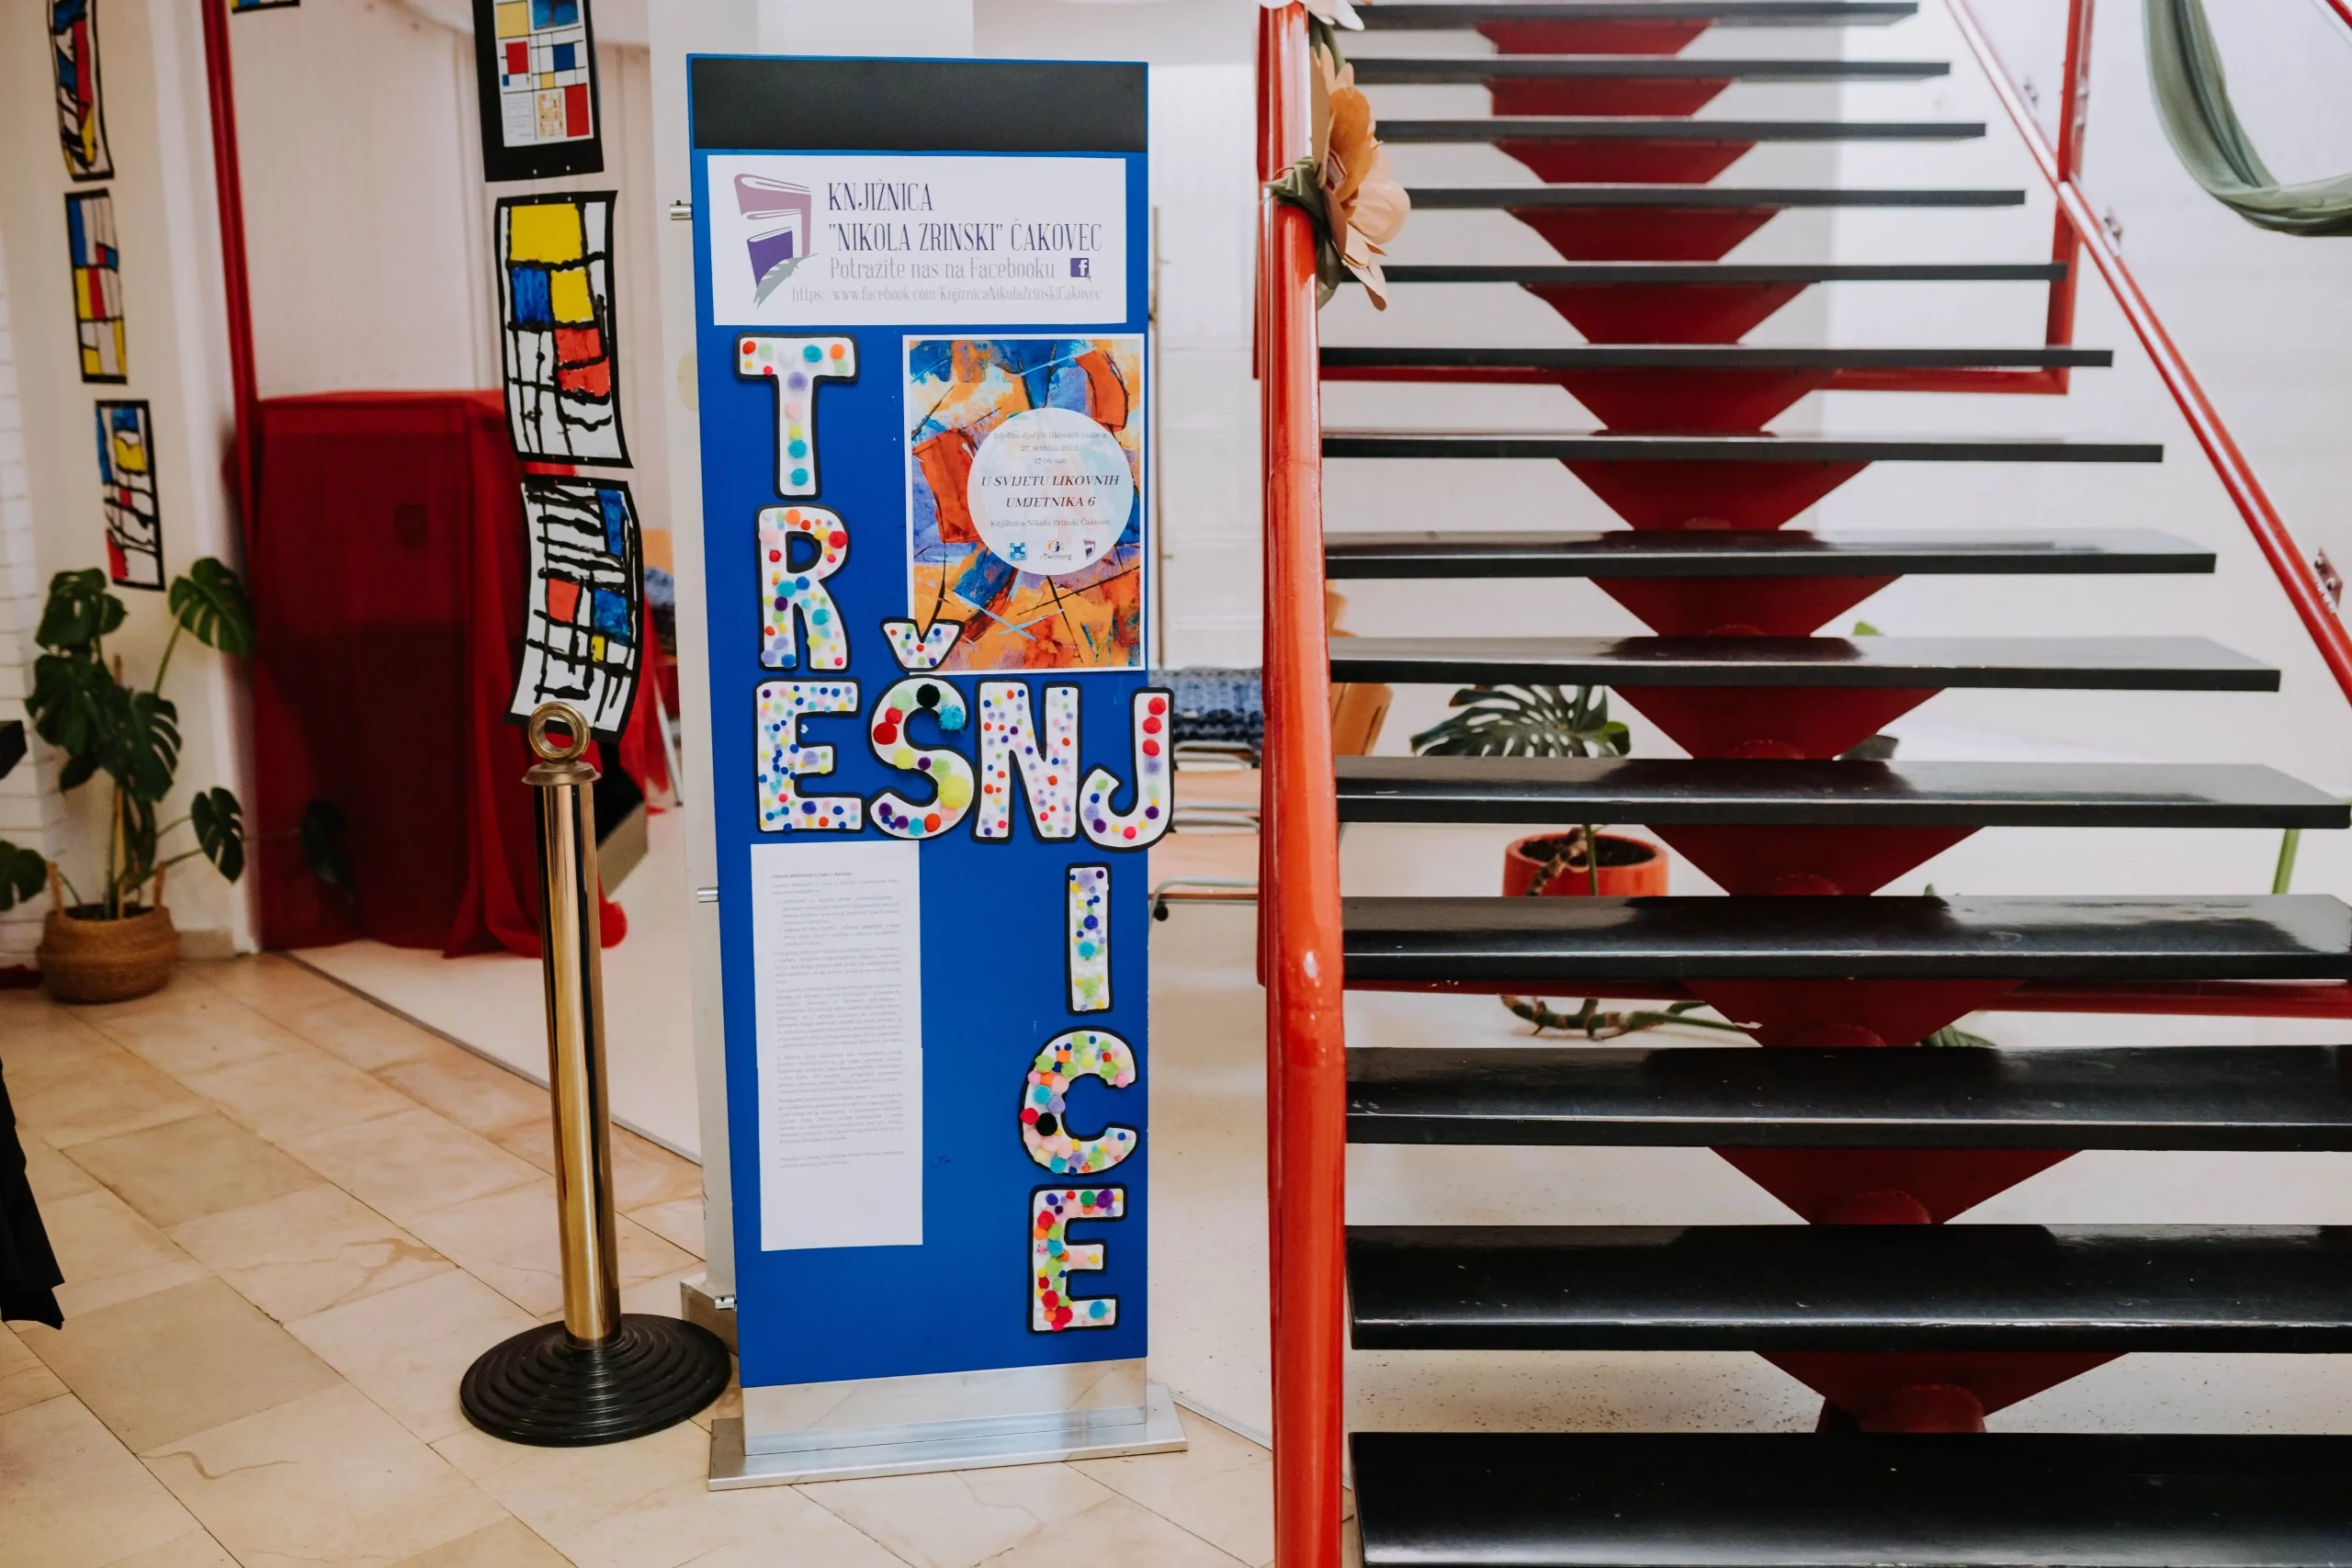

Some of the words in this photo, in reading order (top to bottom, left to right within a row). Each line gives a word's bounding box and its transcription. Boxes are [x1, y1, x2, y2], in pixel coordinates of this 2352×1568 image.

[828, 178, 933, 211] KNJIŽNICA
[829, 222, 911, 251] "NIKOLA
[919, 222, 1003, 251] ZRINSKI"
[1012, 219, 1102, 251] ČAKOVEC
[831, 256, 905, 279] Potražite
[910, 263, 939, 279] nas
[945, 263, 966, 279] na
[970, 256, 1055, 278] Facebooku
[1048, 431, 1080, 439] likovnih
[1081, 431, 1107, 439] radova
[1033, 445, 1059, 453] svibnja
[981, 476, 992, 487] U
[993, 476, 1050, 487] SVIJETU
[1052, 475, 1120, 486] LIKOVNIH
[1006, 496, 1084, 508] UMJETNIKA
[1087, 496, 1096, 506] 6
[990, 519, 1025, 528] Knjižnica
[1052, 518, 1080, 527] Zrinski
[1080, 516, 1112, 526] Čakovec
